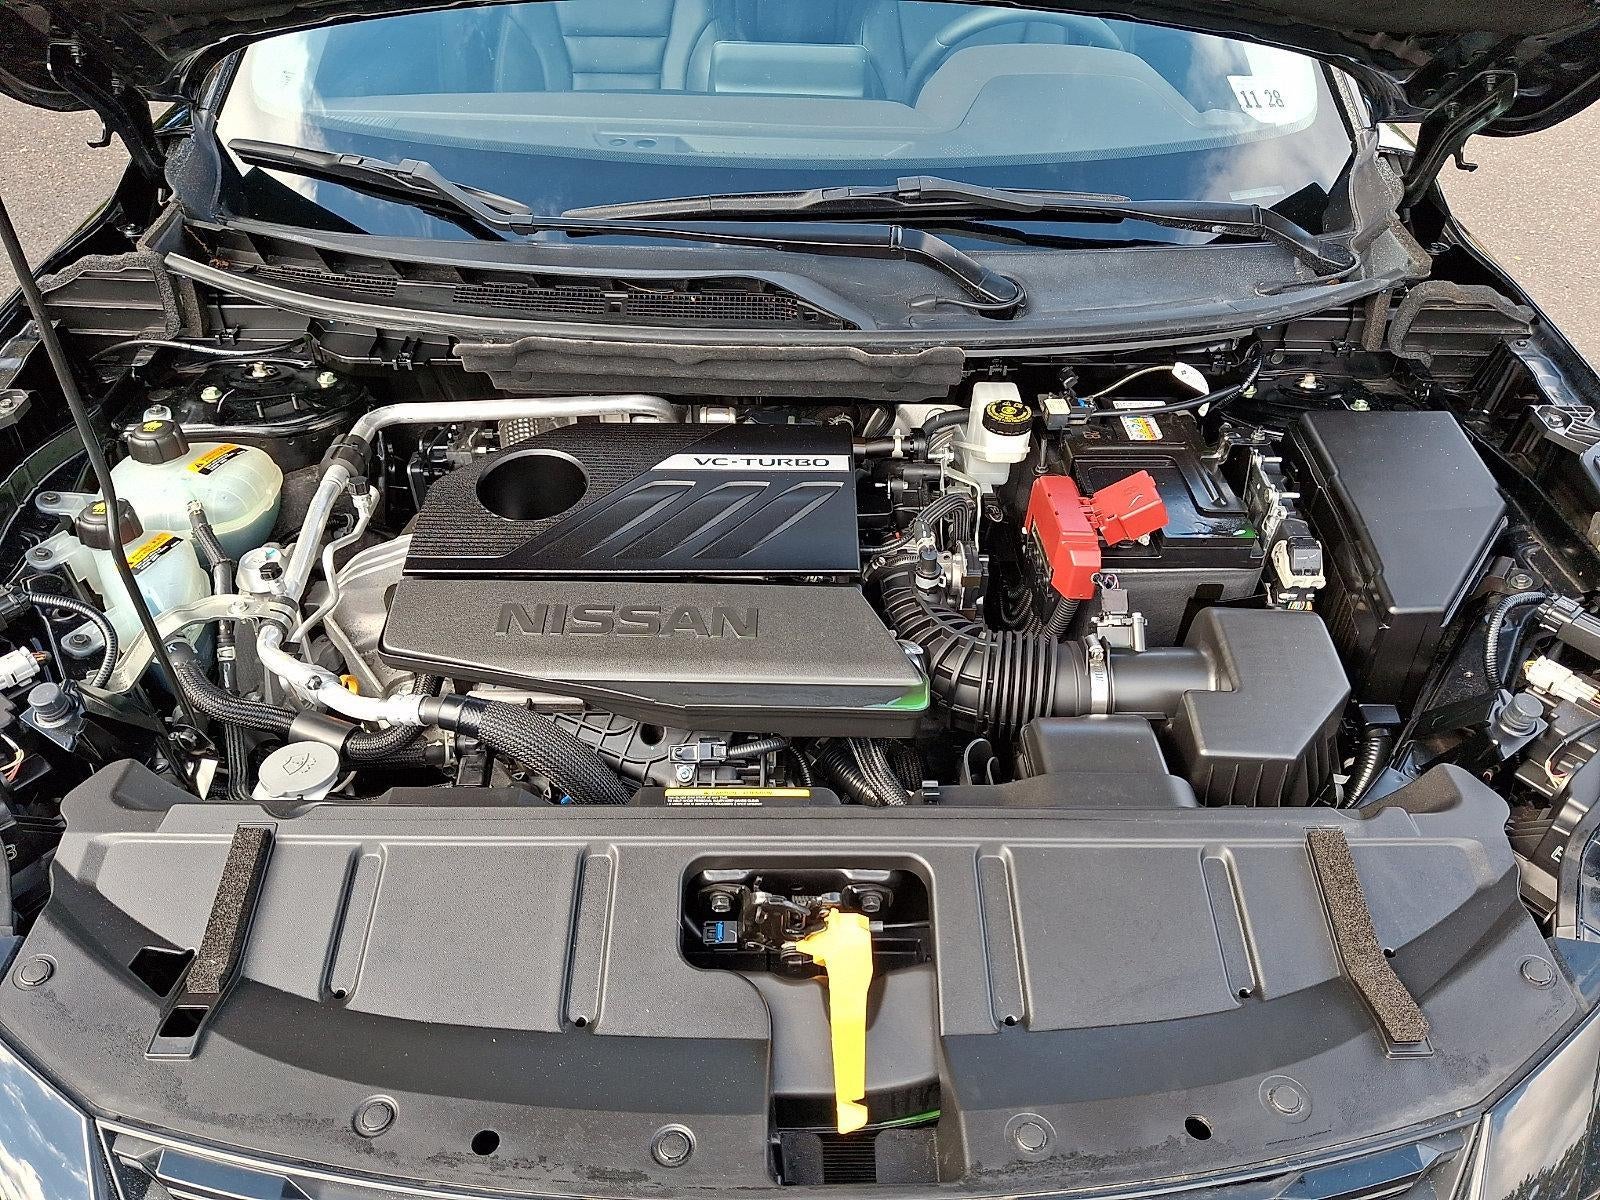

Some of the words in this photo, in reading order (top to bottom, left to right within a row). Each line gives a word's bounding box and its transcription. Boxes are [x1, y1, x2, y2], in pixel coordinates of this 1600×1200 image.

[1240, 90, 1262, 108] 11
[1264, 89, 1285, 108] 28
[693, 457, 830, 467] VC-TURBO
[494, 602, 760, 640] NISSAN
